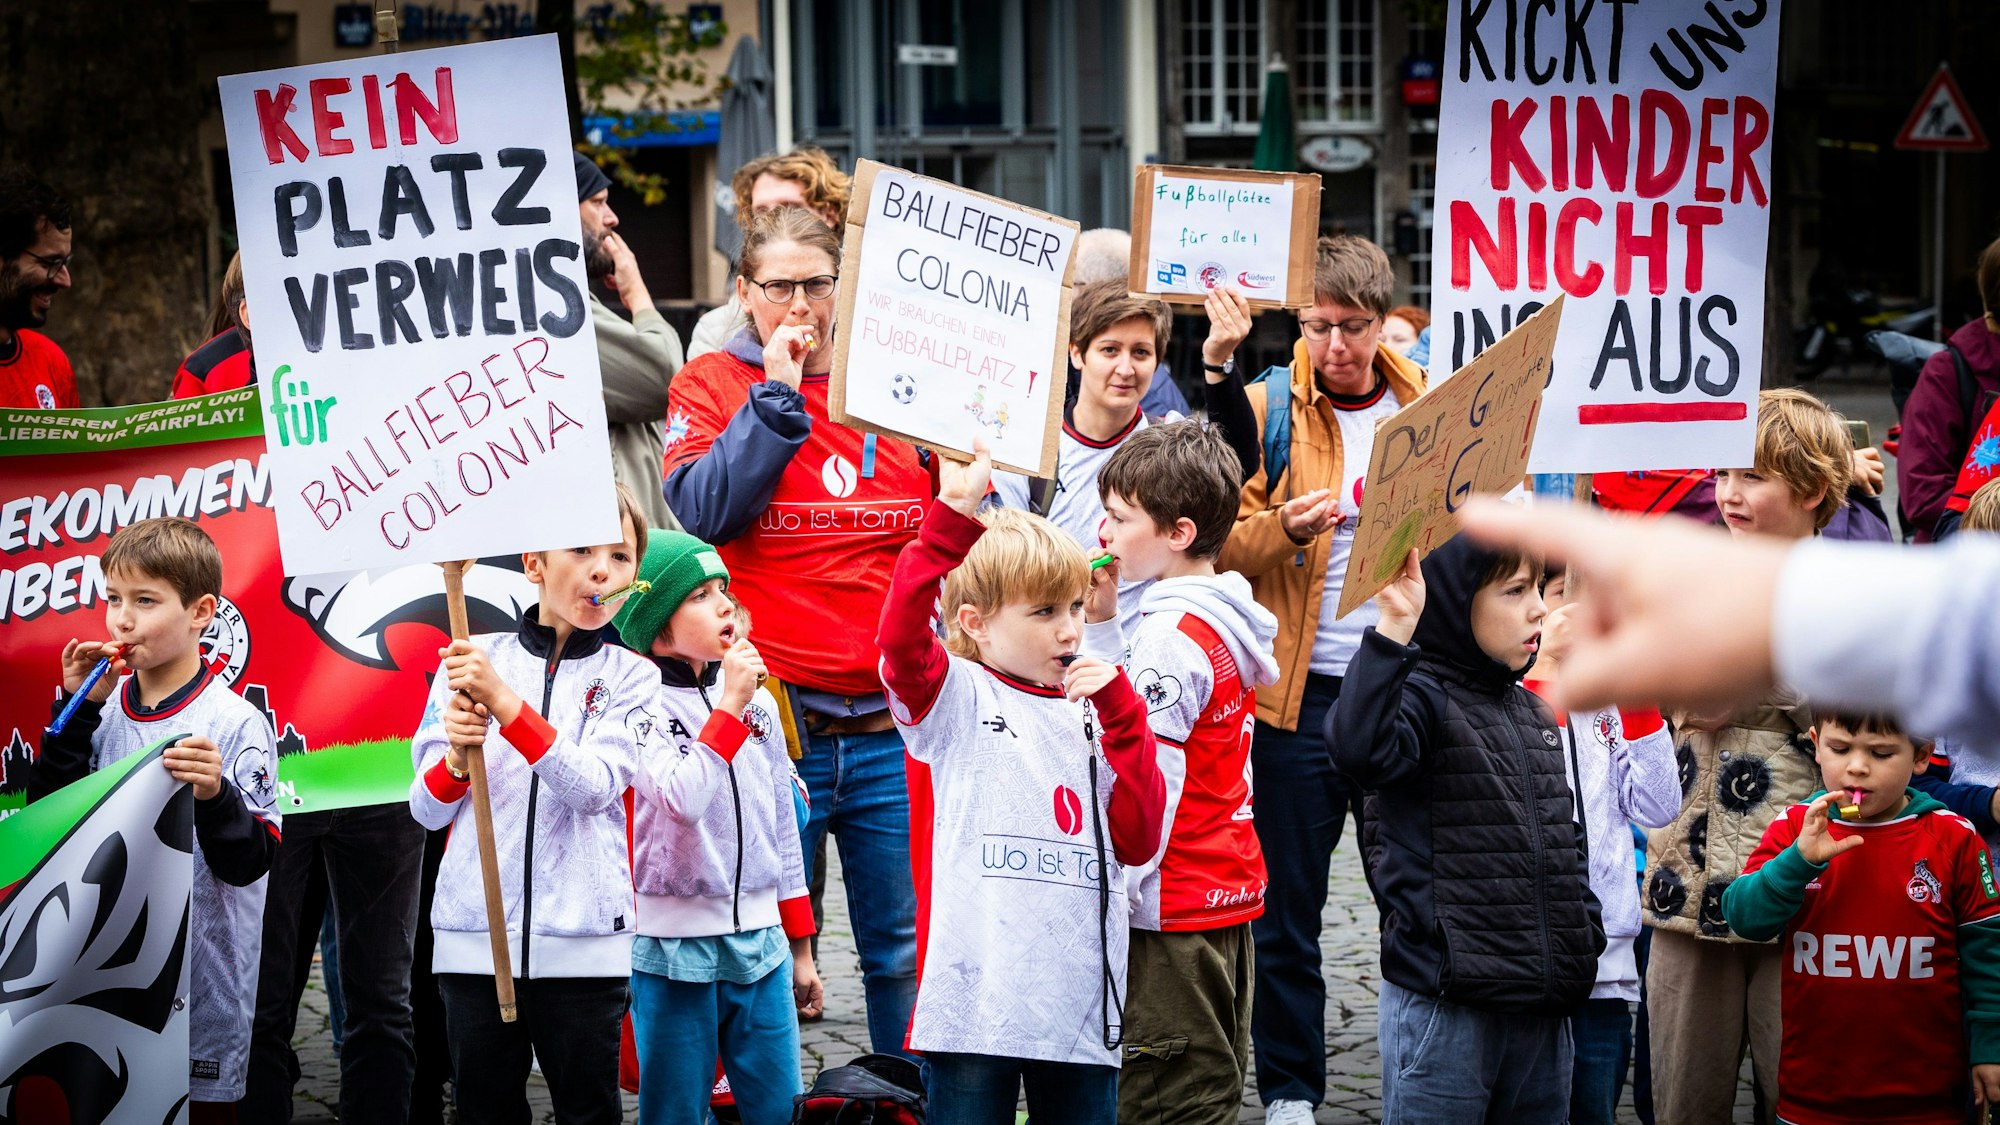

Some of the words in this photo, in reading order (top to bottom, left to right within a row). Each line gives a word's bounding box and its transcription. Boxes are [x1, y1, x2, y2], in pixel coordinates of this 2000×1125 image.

[1459, 0, 1638, 86] KICKT
[1650, 0, 1768, 91] UNS
[254, 66, 460, 166] KEIN
[1490, 88, 1770, 209] KINDER
[274, 147, 552, 258] PLATZ
[883, 181, 1061, 272] BALLFIEBER
[1156, 184, 1271, 213] Fußballplätze
[1179, 227, 1209, 248] für
[1450, 197, 1724, 298] NICHT
[284, 238, 586, 353] VERWEIS
[897, 248, 1030, 322] COLONIA
[1246, 273, 1276, 282] Südwest
[868, 289, 892, 312] WIR
[898, 303, 966, 336] BRAUCHEN
[973, 325, 1006, 349] EINEN
[1588, 294, 1741, 397] AUS
[7, 413, 118, 430] UNSEREN
[124, 400, 203, 425] VEREIN
[206, 390, 254, 407] UND
[85, 427, 129, 443] WIR
[133, 407, 246, 435] FAIRPLAY!
[270, 364, 338, 447] für
[300, 337, 565, 531] BALLFIEBER
[380, 400, 585, 551] COLONIA
[1376, 412, 1446, 486] Der
[759, 509, 801, 531] Wo
[810, 508, 842, 529] ist
[845, 504, 924, 529] Tom?
[1367, 482, 1420, 550] Bleibt
[982, 843, 1028, 870] Wo
[1037, 848, 1067, 876] ist
[1979, 855, 1996, 896] DEVK
[1205, 886, 1255, 909] Liebe
[1793, 931, 1936, 980] REWE
